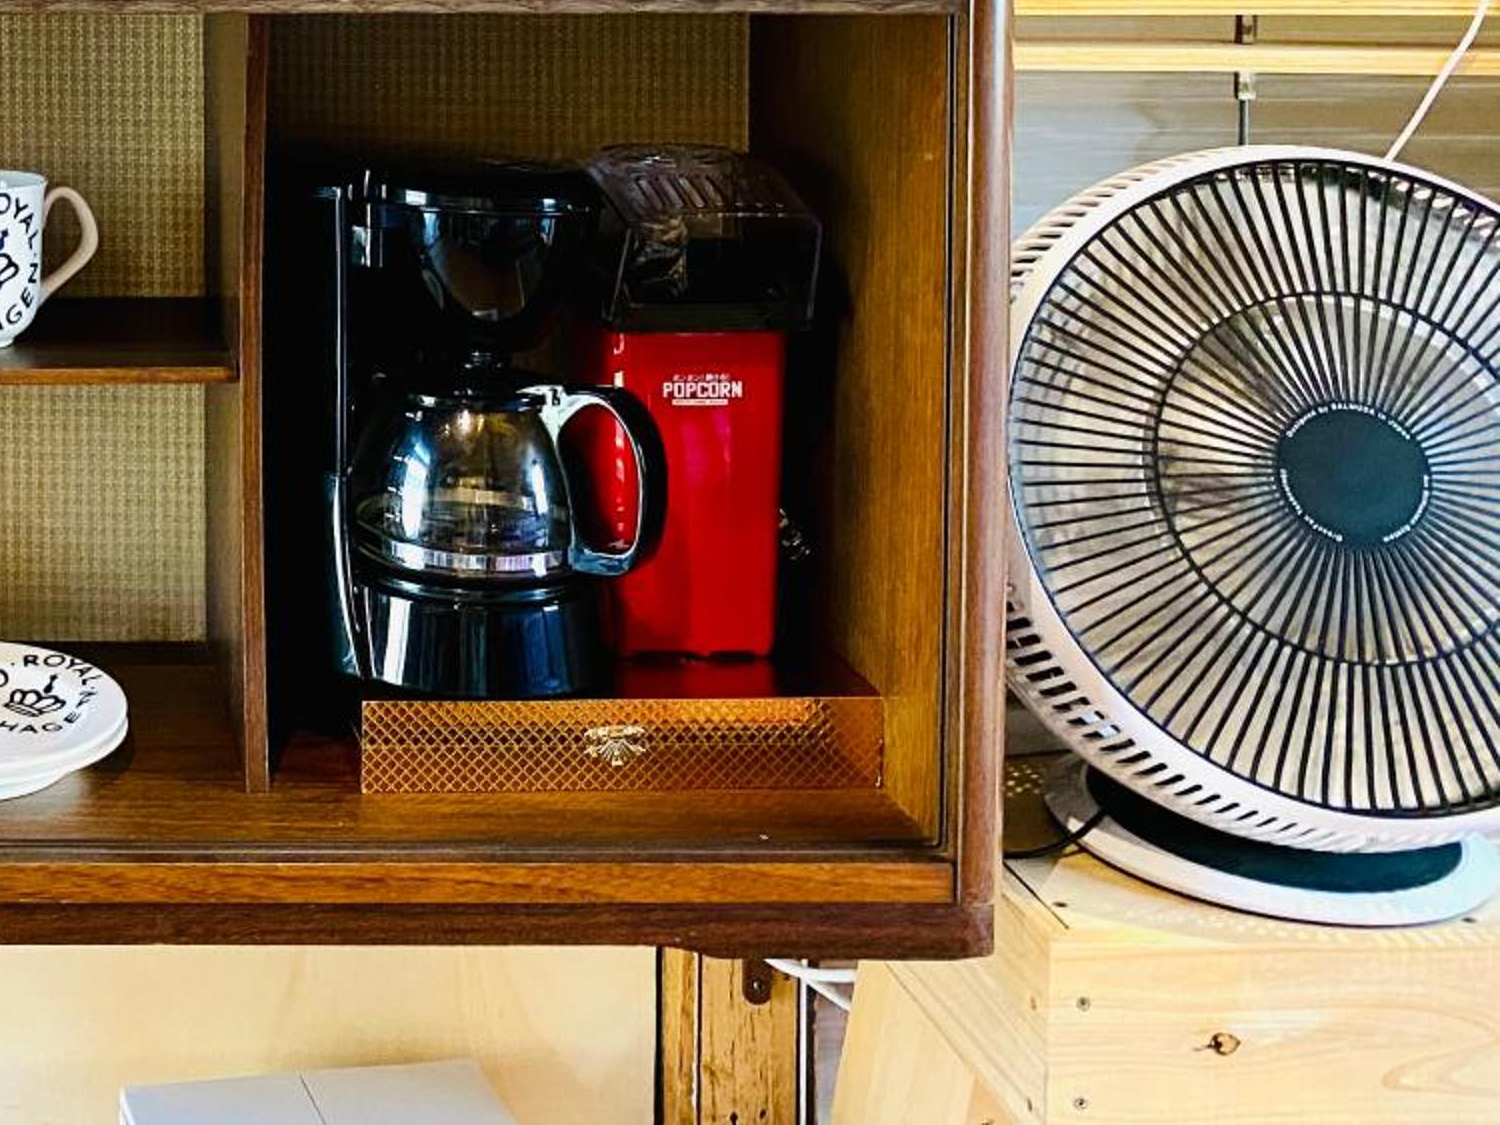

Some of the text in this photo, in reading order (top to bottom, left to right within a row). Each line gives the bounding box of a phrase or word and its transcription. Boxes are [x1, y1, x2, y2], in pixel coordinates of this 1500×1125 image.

[662, 381, 743, 398] POPCORN
[1331, 402, 1376, 415] BALMUDA
[23, 654, 103, 686] ROYAL
